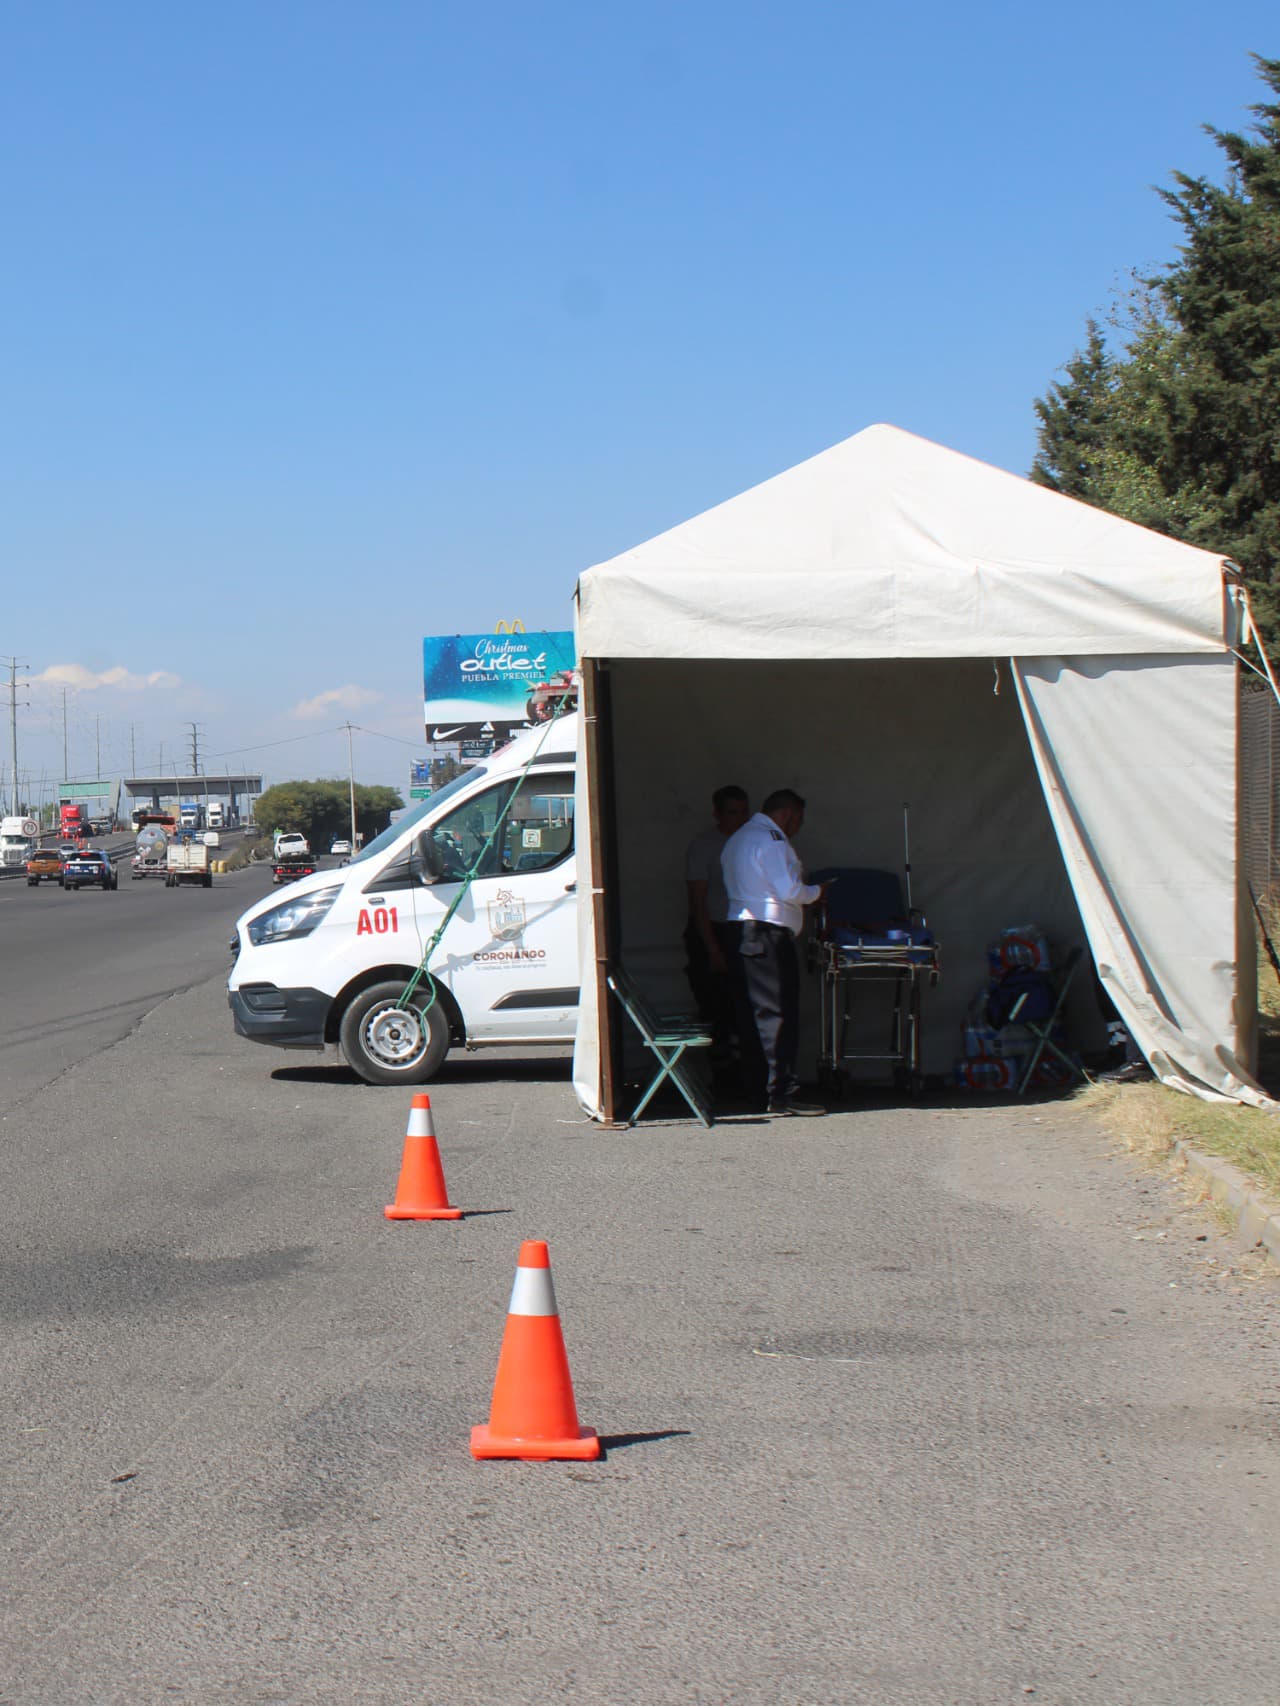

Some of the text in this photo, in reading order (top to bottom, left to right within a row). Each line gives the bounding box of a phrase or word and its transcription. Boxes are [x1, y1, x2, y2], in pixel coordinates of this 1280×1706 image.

[475, 638, 528, 658] Christmas
[460, 652, 546, 671] outlet
[462, 671, 545, 682] PUEBLA PREMIER
[357, 907, 398, 935] A01
[473, 949, 545, 961] CORONANGO
